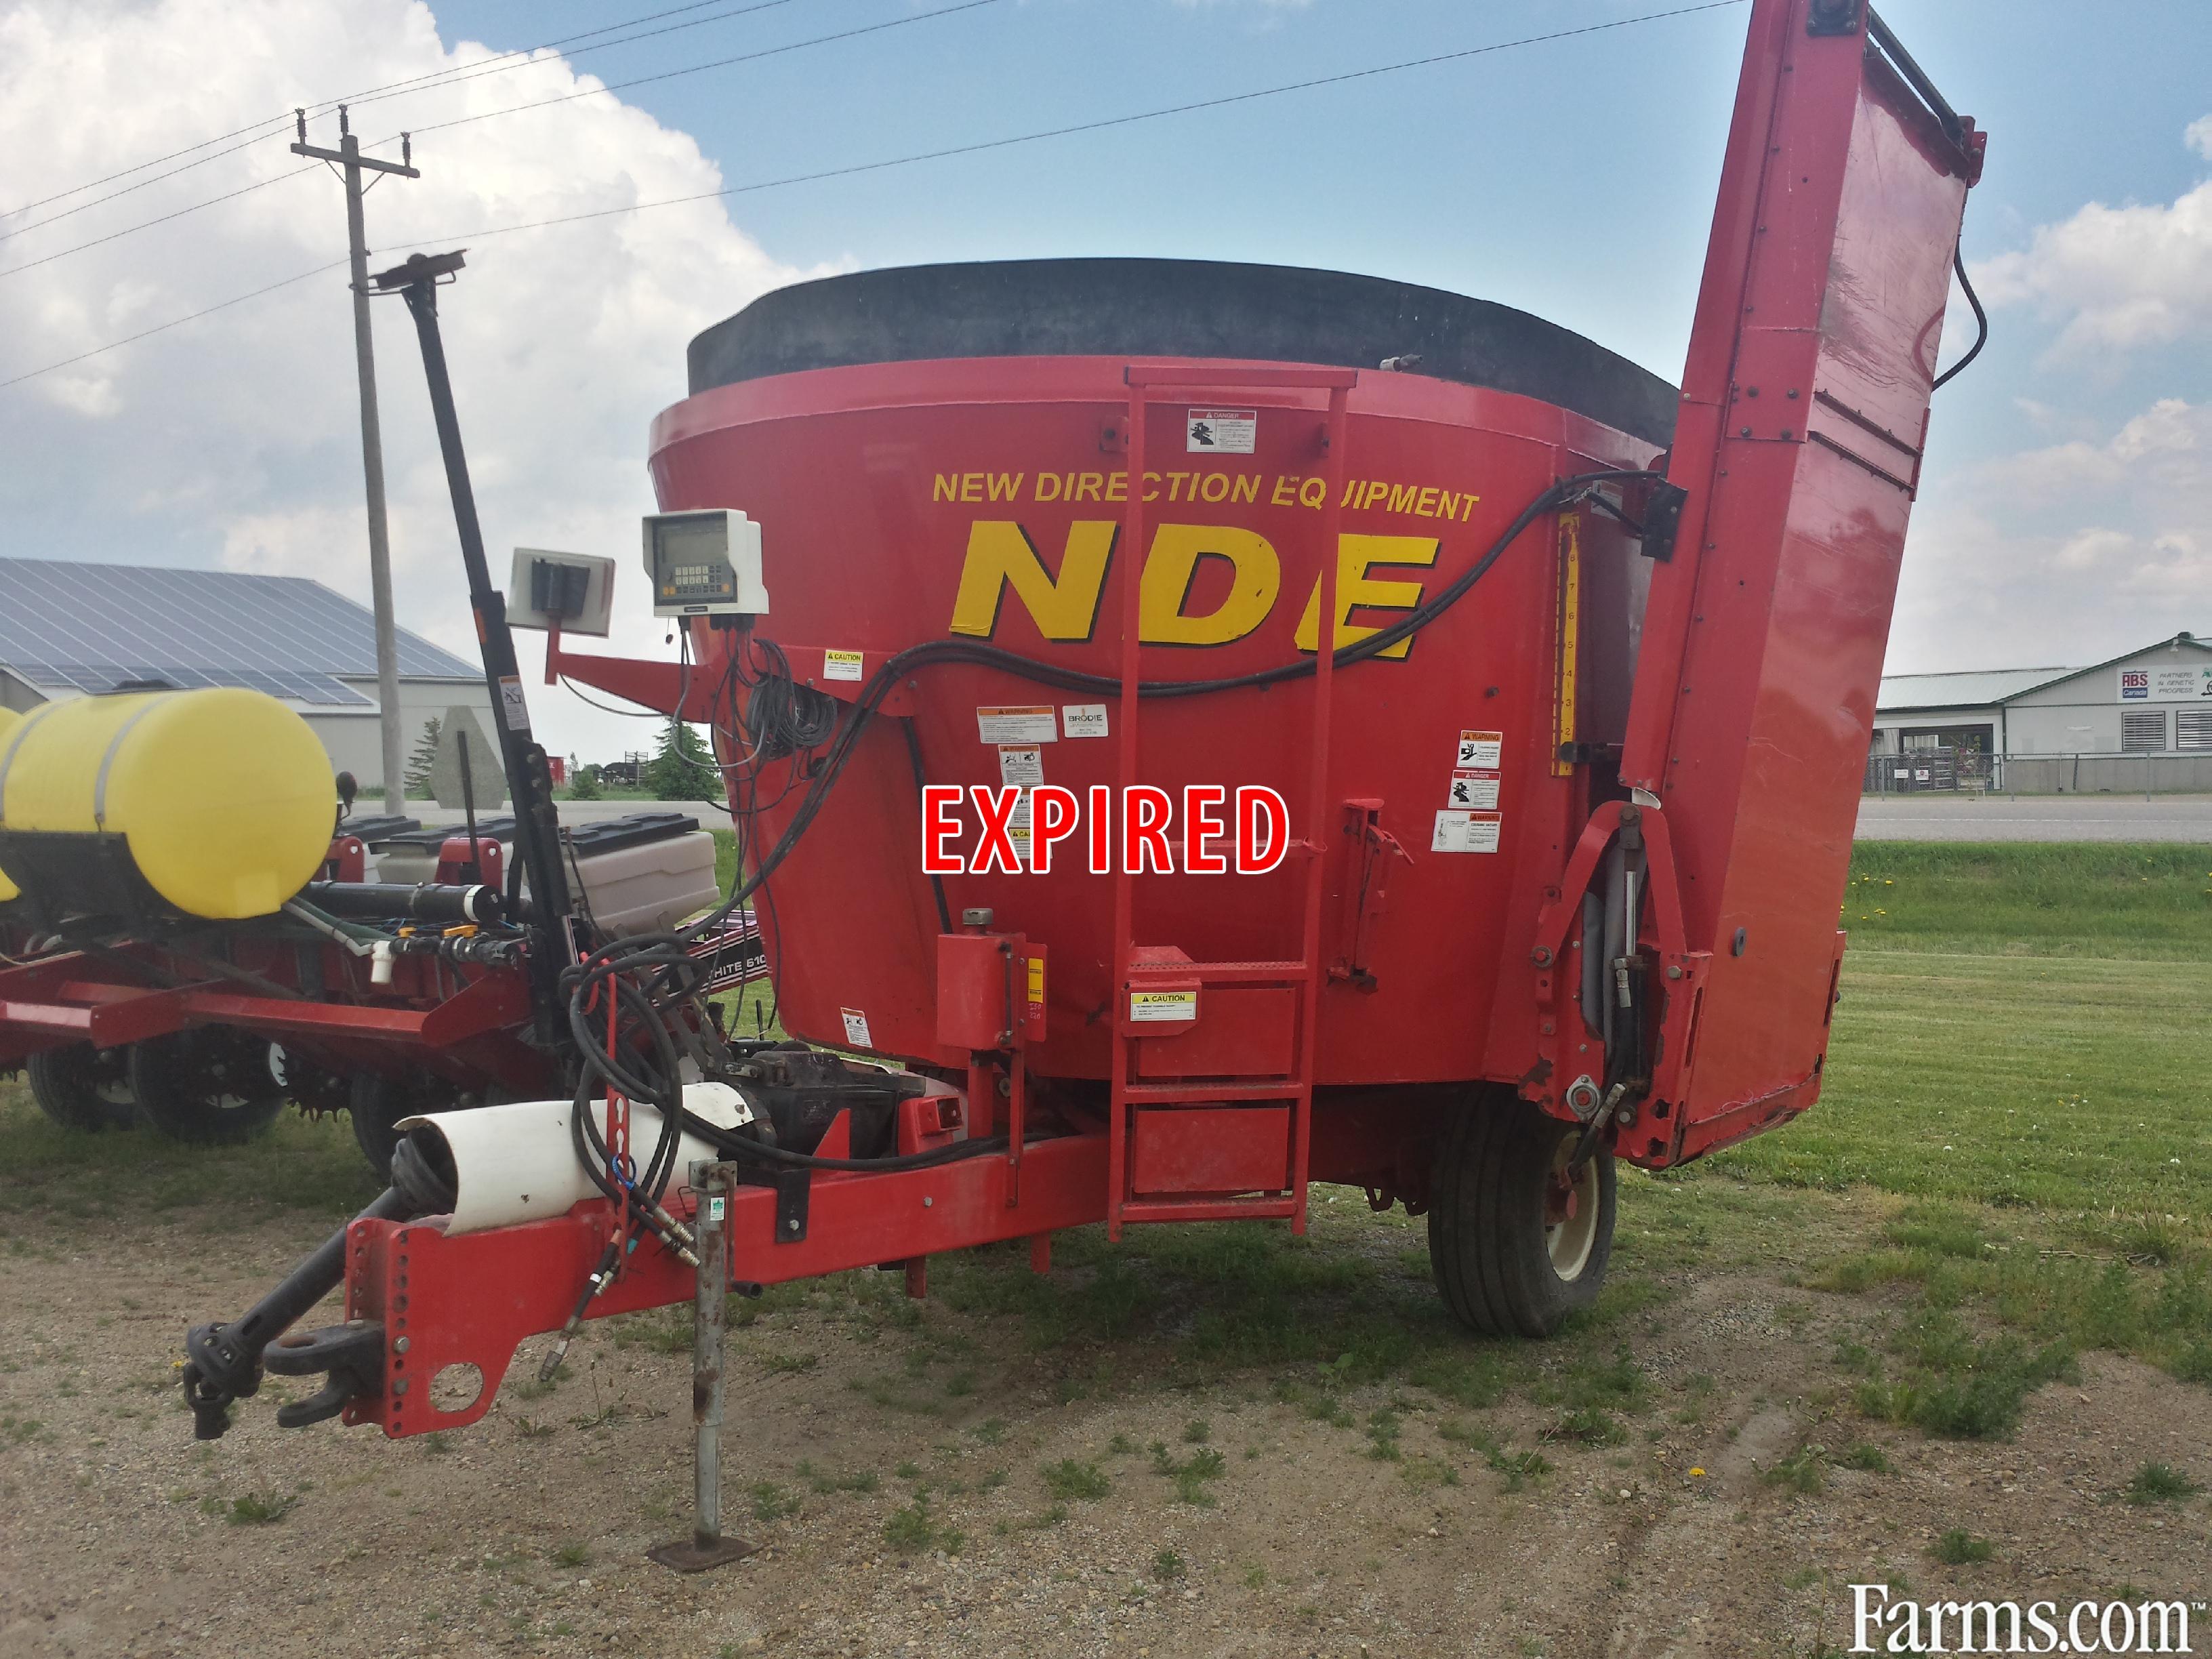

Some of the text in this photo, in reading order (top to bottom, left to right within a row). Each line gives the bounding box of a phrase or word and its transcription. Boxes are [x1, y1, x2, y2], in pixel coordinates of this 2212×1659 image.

[933, 472, 1480, 523] NEW DIRECTION EQUIPMENT
[949, 520, 1441, 661] NDE
[2123, 674, 2148, 687] ABS
[709, 961, 742, 979] HITE
